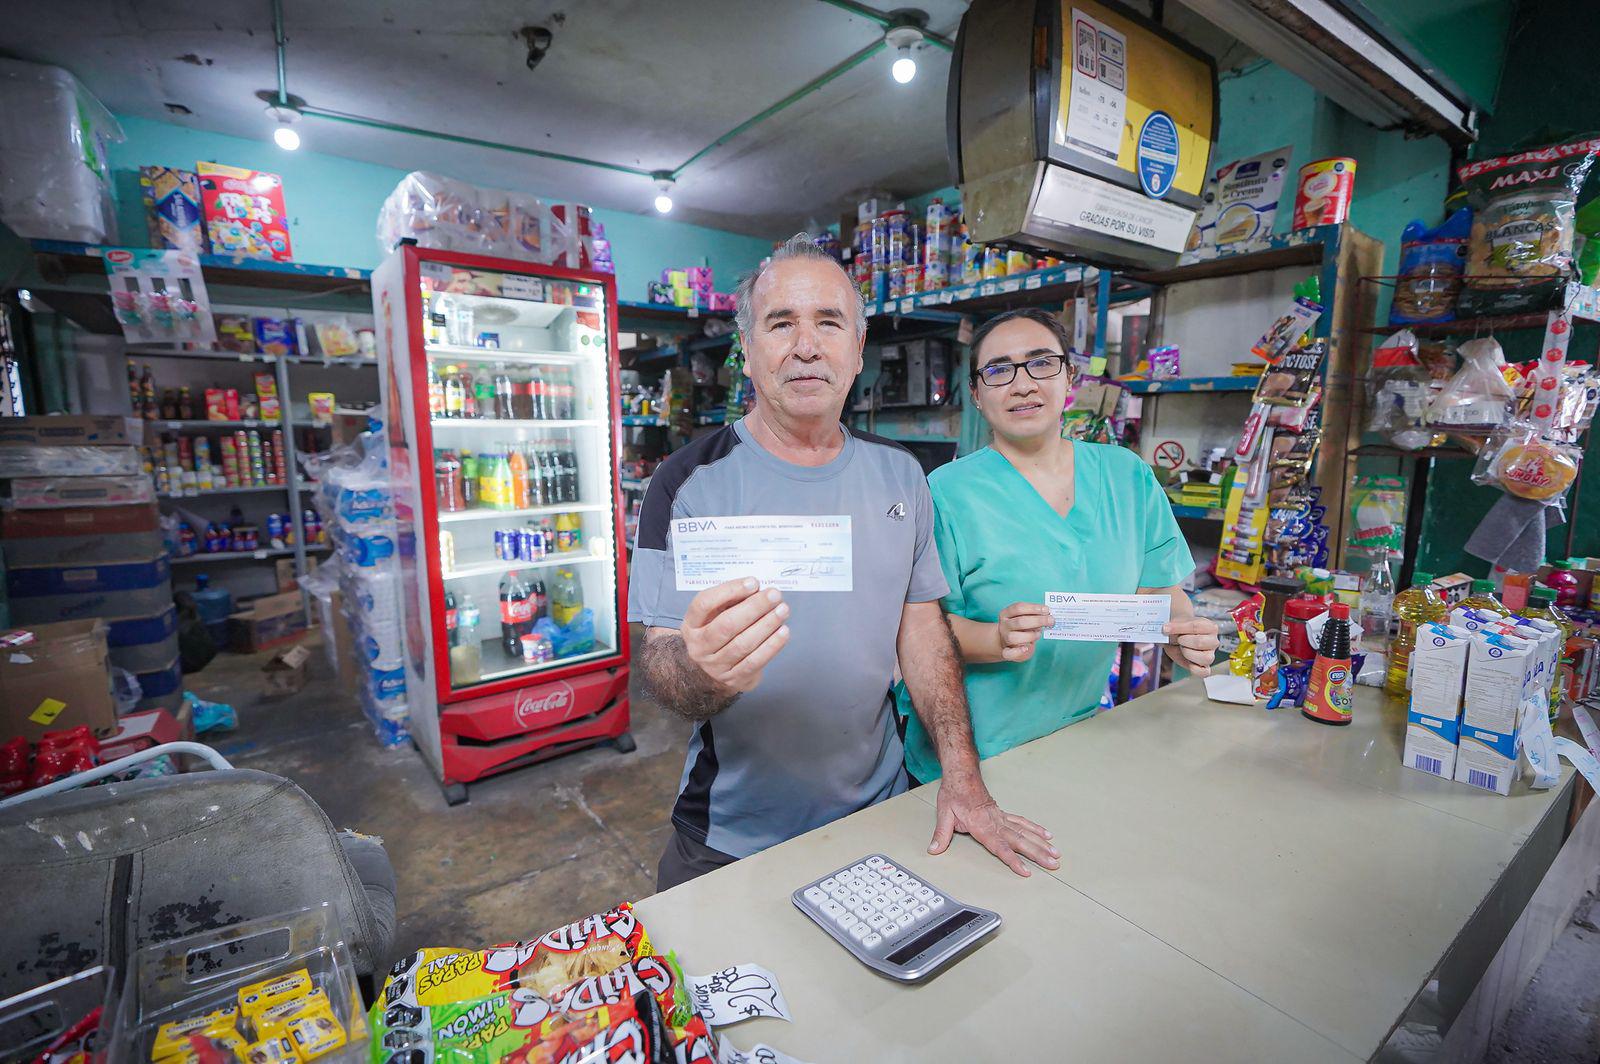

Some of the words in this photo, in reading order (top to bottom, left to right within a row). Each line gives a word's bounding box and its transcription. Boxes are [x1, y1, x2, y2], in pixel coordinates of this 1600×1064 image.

[1506, 138, 1600, 164] GRATIS
[1489, 166, 1560, 190] MAXI
[1080, 211, 1109, 228] GRACIAS
[1109, 219, 1125, 232] POR
[1127, 222, 1138, 234] SU
[1485, 221, 1554, 241] BLANCAS
[677, 520, 718, 533] BBVA
[1049, 595, 1077, 603] BBVA
[418, 953, 481, 996] PAPAS
[425, 954, 459, 974] SAL
[512, 955, 672, 1027] CHiDAS
[438, 996, 504, 1040] LIMÓN
[466, 1013, 497, 1036] SABOR
[457, 1015, 510, 1049] PAP
